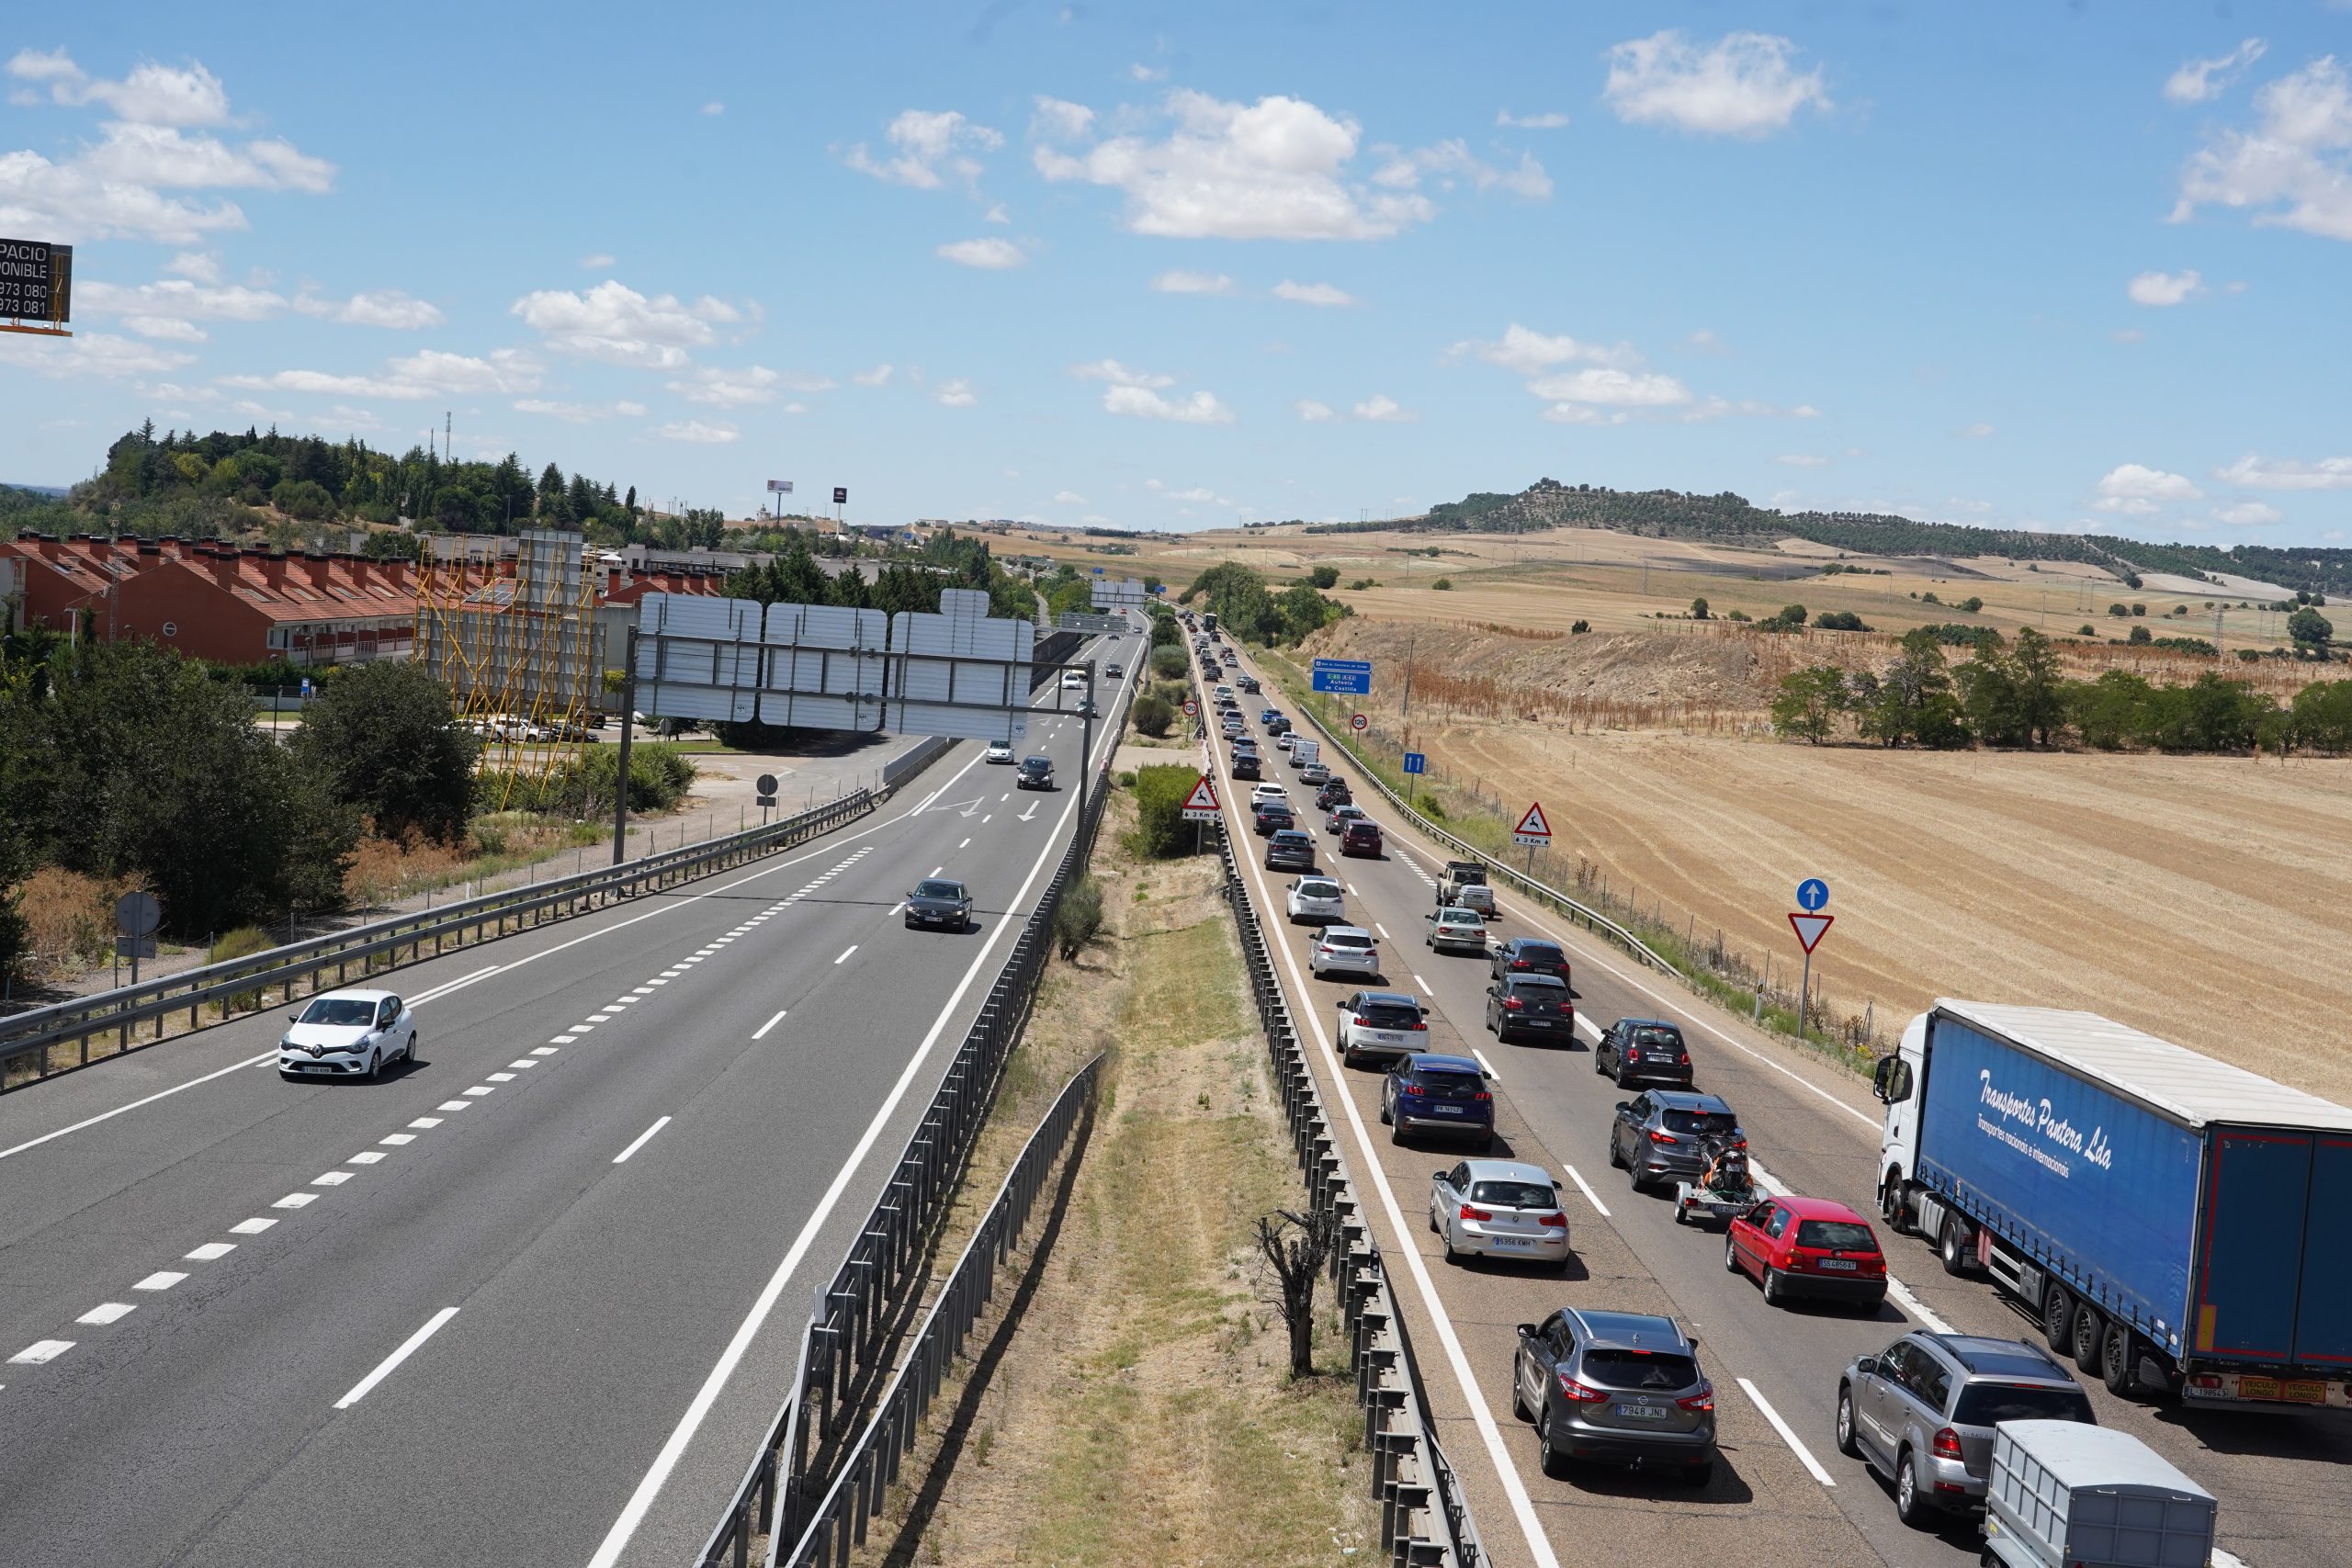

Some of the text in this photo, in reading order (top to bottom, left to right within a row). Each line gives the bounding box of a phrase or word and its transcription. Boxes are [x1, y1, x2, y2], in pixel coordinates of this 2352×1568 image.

[0, 261, 47, 278] ONIBLE
[24, 284, 47, 299] 080
[23, 300, 45, 315] 081
[1980, 1069, 2112, 1170] Transportes Pantera Lda
[1977, 1112, 2005, 1142] Transportes
[2005, 1132, 2029, 1156] nacionais
[2032, 1144, 2069, 1179] internacionais
[2244, 1380, 2278, 1389] VEICULO
[2288, 1383, 2322, 1392] VEICULO
[2245, 1388, 2274, 1396] LONGO
[2289, 1391, 2319, 1400] LONGO
[1623, 1405, 1665, 1417] 7948 JNL
